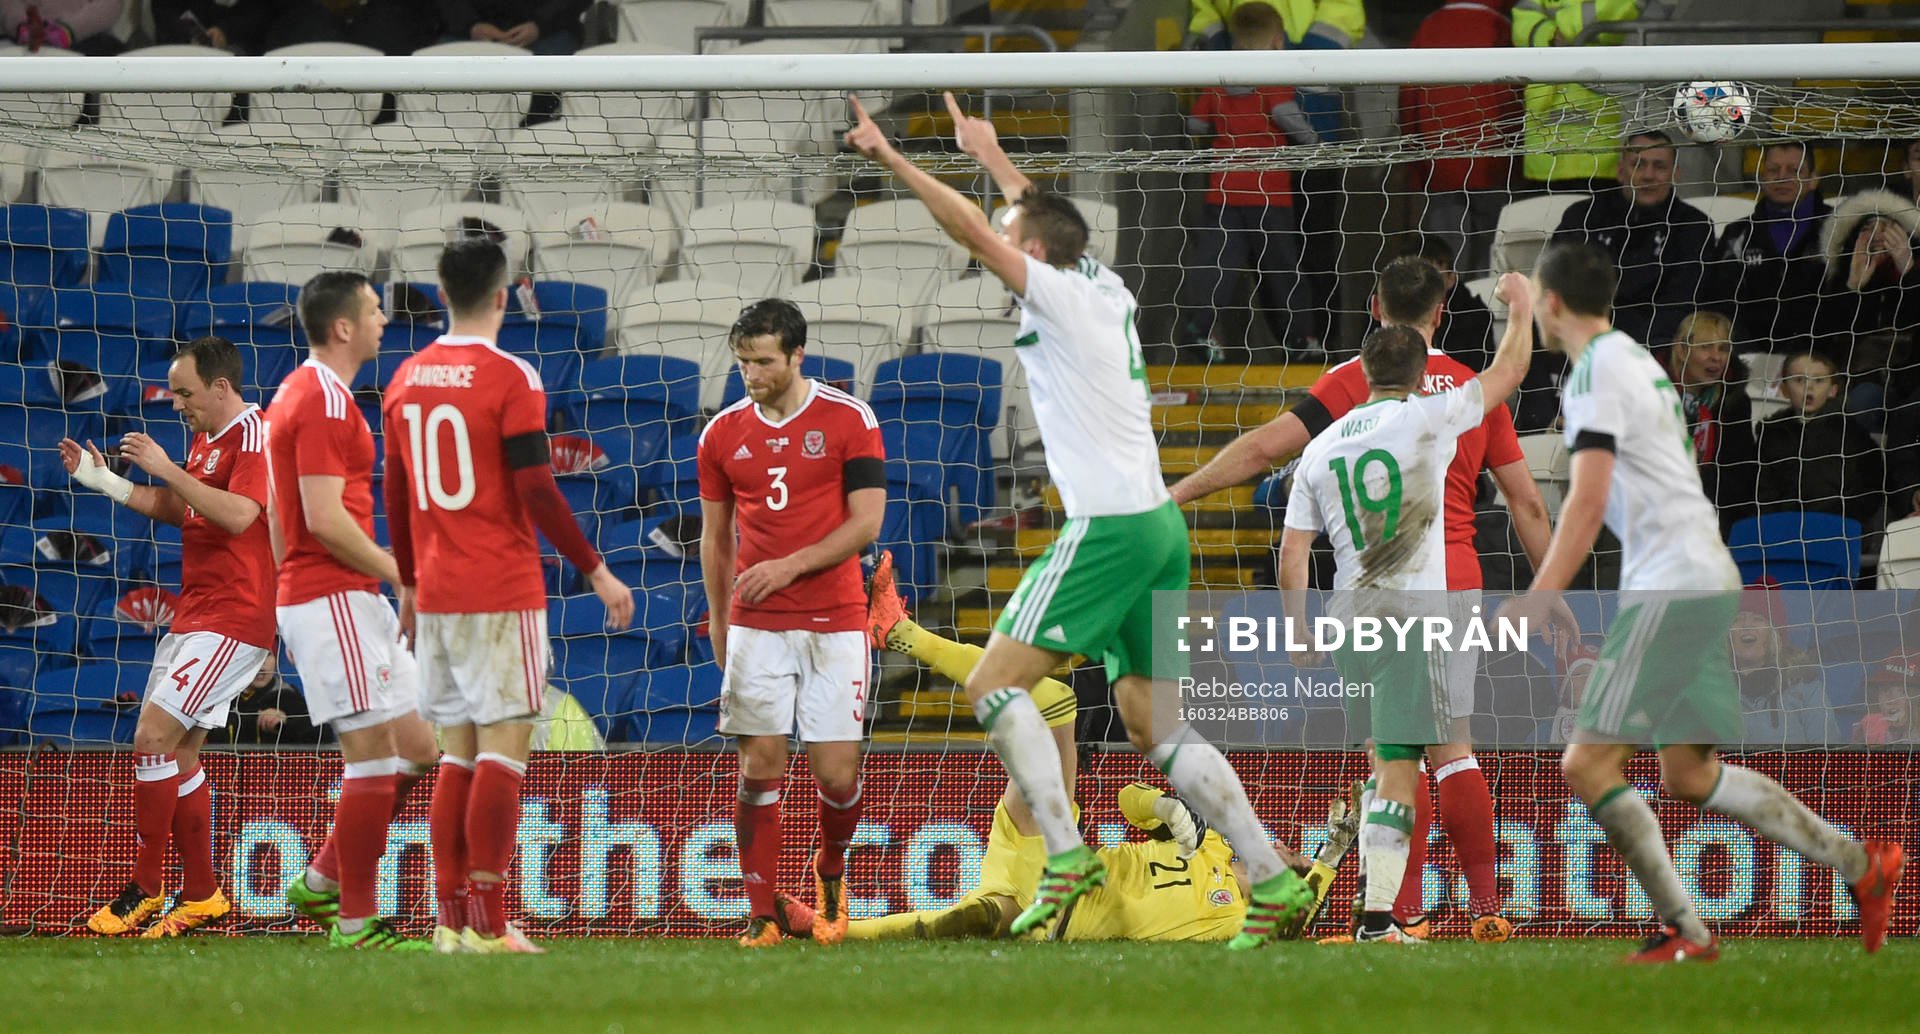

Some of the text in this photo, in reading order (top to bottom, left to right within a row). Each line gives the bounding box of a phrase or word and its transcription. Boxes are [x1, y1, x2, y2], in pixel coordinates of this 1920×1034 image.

[405, 363, 477, 388] LAWRENCE
[402, 403, 476, 511] 10
[766, 466, 788, 511] 3
[1328, 448, 1403, 551] 19
[171, 657, 200, 691] 4
[852, 681, 864, 721] 3
[516, 784, 752, 918] the
[1149, 856, 1192, 889] 21
